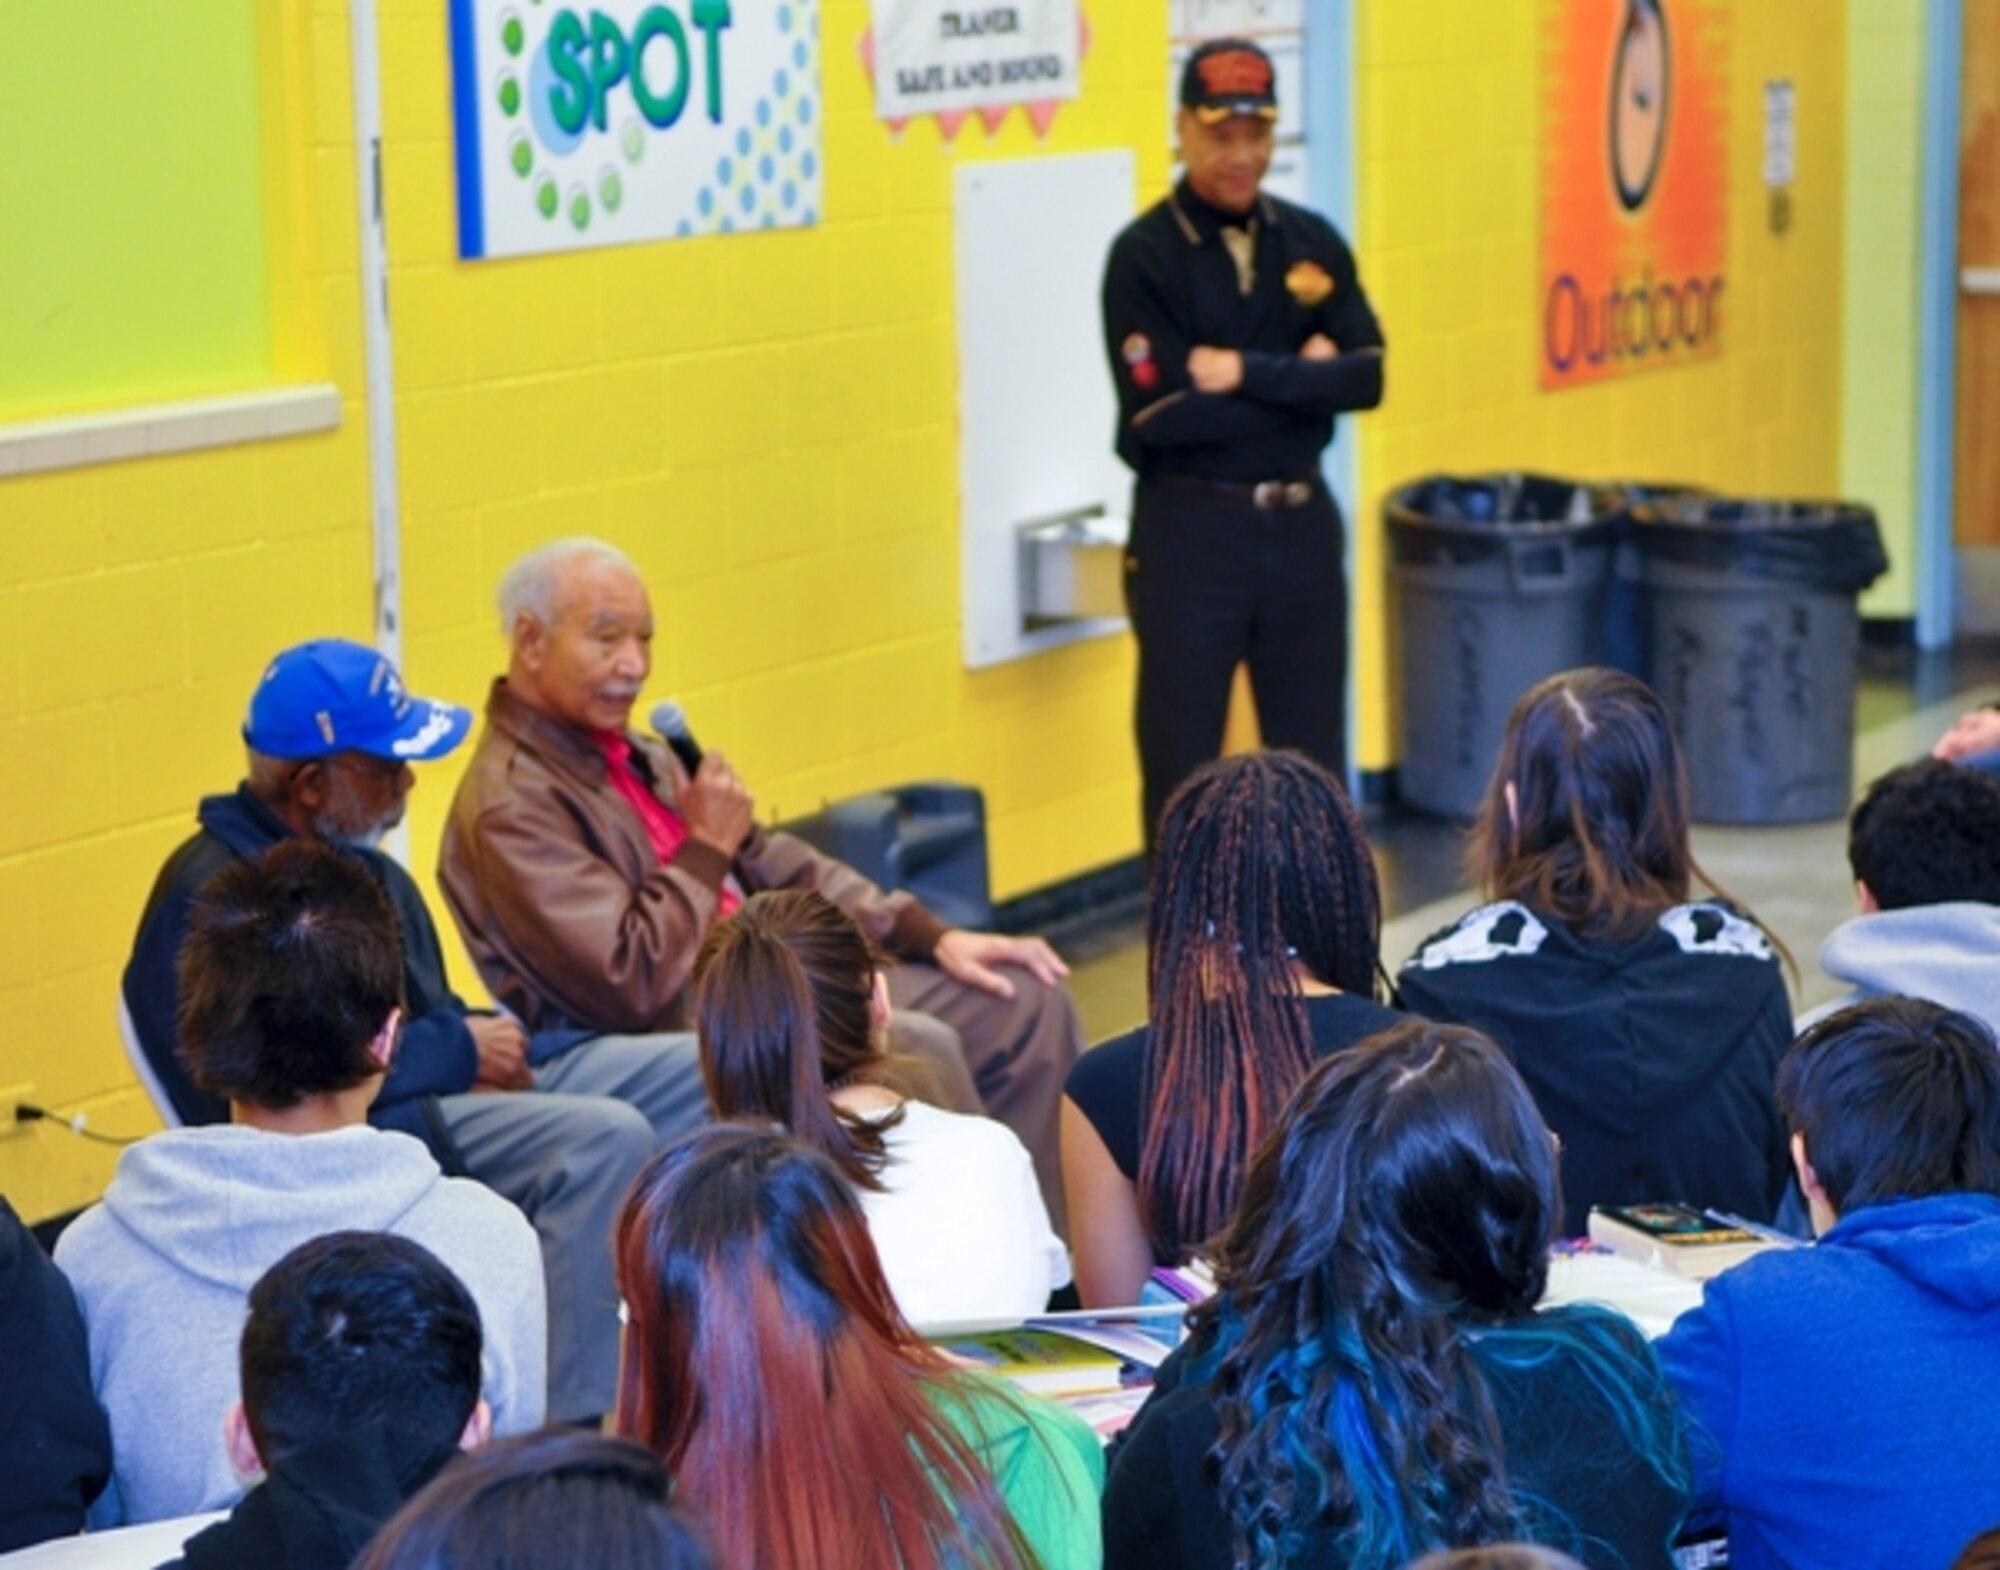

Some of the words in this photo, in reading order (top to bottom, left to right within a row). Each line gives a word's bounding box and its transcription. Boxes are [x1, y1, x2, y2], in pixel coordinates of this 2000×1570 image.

[547, 0, 731, 136] SPOT
[896, 64, 944, 95] SAFE
[952, 60, 993, 88] AND
[1000, 54, 1062, 83] SOUND
[1544, 264, 1726, 374] Outdoor
